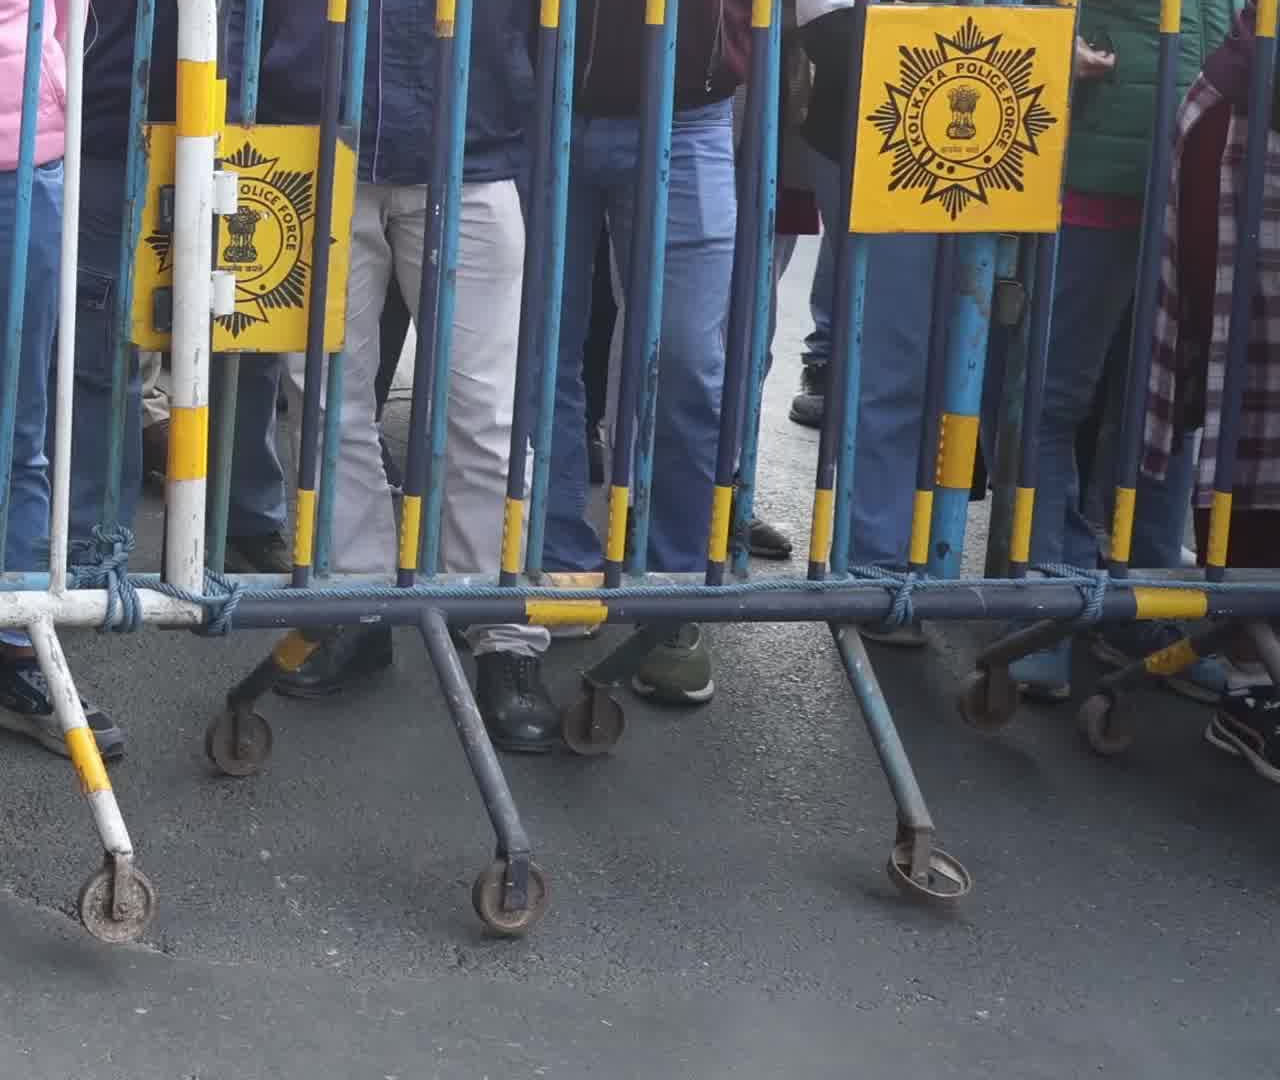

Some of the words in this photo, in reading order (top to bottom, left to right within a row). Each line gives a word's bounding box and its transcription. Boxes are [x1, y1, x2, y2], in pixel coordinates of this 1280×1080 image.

[907, 69, 948, 147] KOLKATA
[955, 62, 1009, 94] POLICE
[996, 95, 1016, 151] FORCE
[239, 184, 279, 204] OLICE
[278, 204, 298, 252] FORCE
